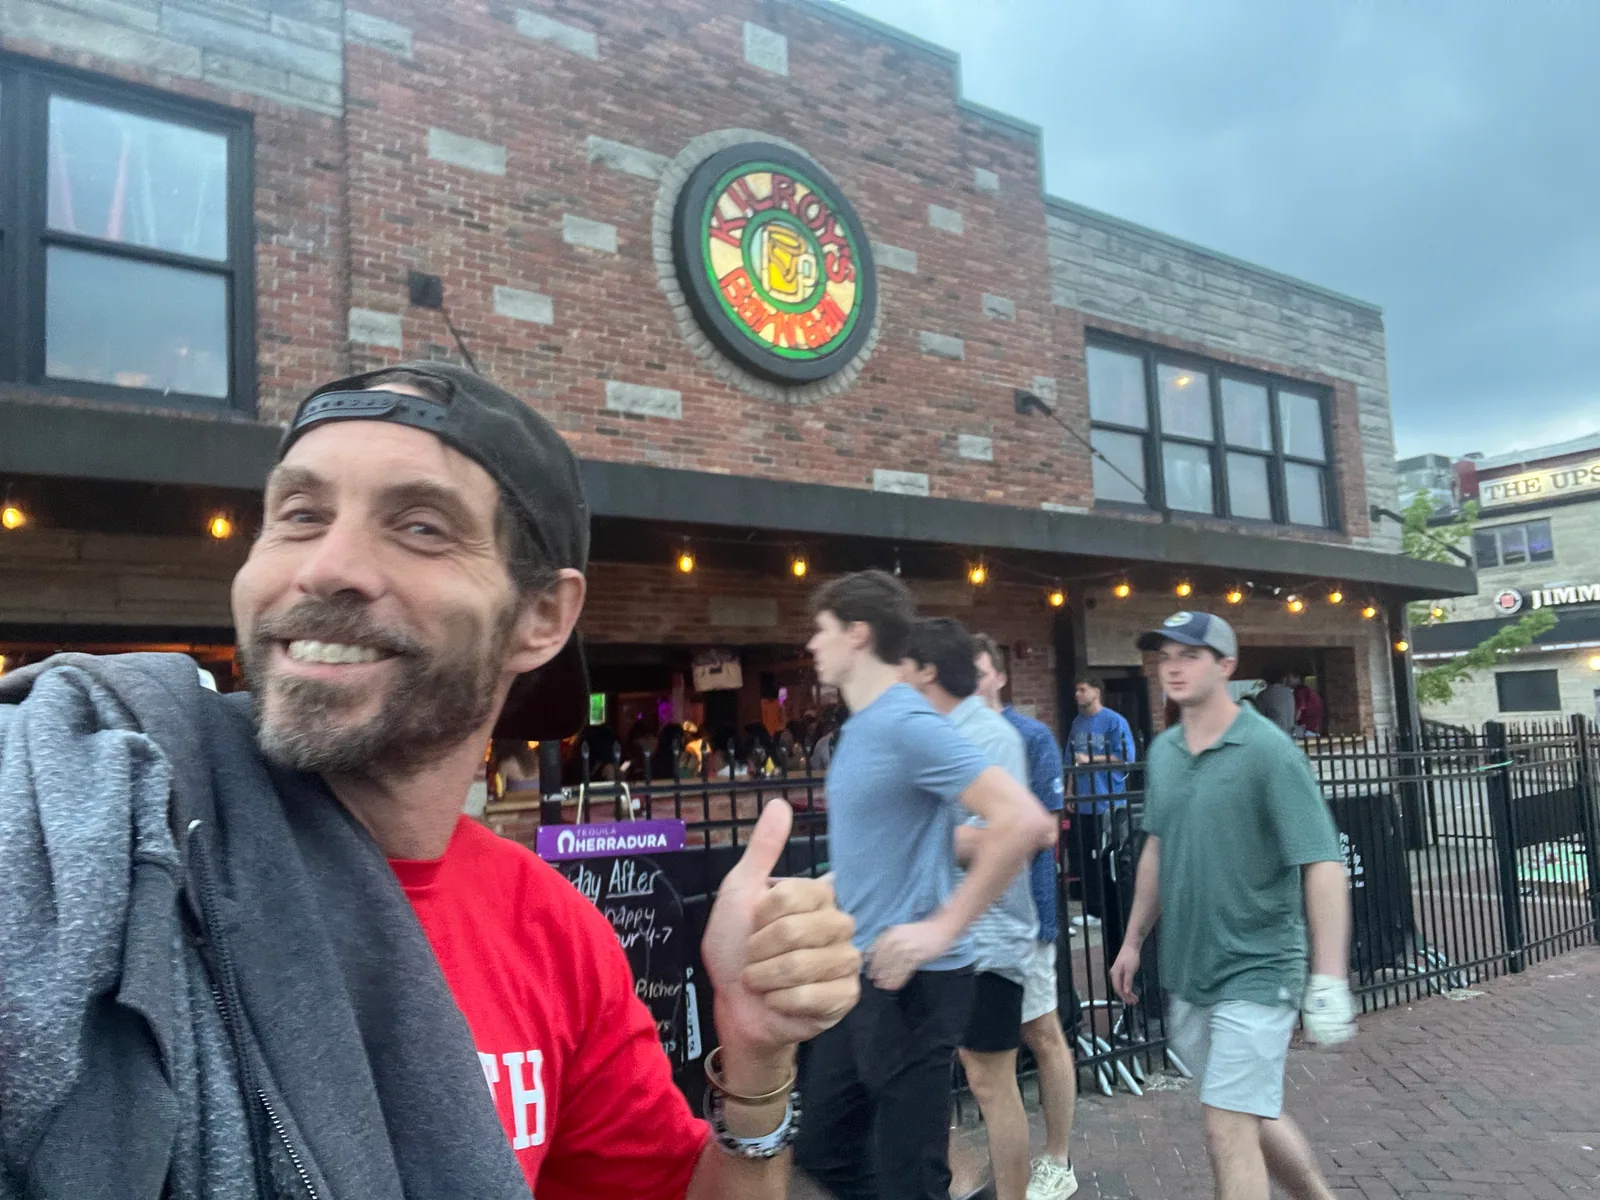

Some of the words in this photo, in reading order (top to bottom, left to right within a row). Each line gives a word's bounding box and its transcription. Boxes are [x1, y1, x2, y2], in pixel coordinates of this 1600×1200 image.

[1484, 477, 1541, 499] THE
[1531, 584, 1600, 610] JIMM
[575, 833, 668, 852] HERRADURA
[576, 827, 617, 836] TEQUILA
[567, 864, 602, 905] day
[608, 858, 662, 893] After
[639, 926, 672, 948] 4-7
